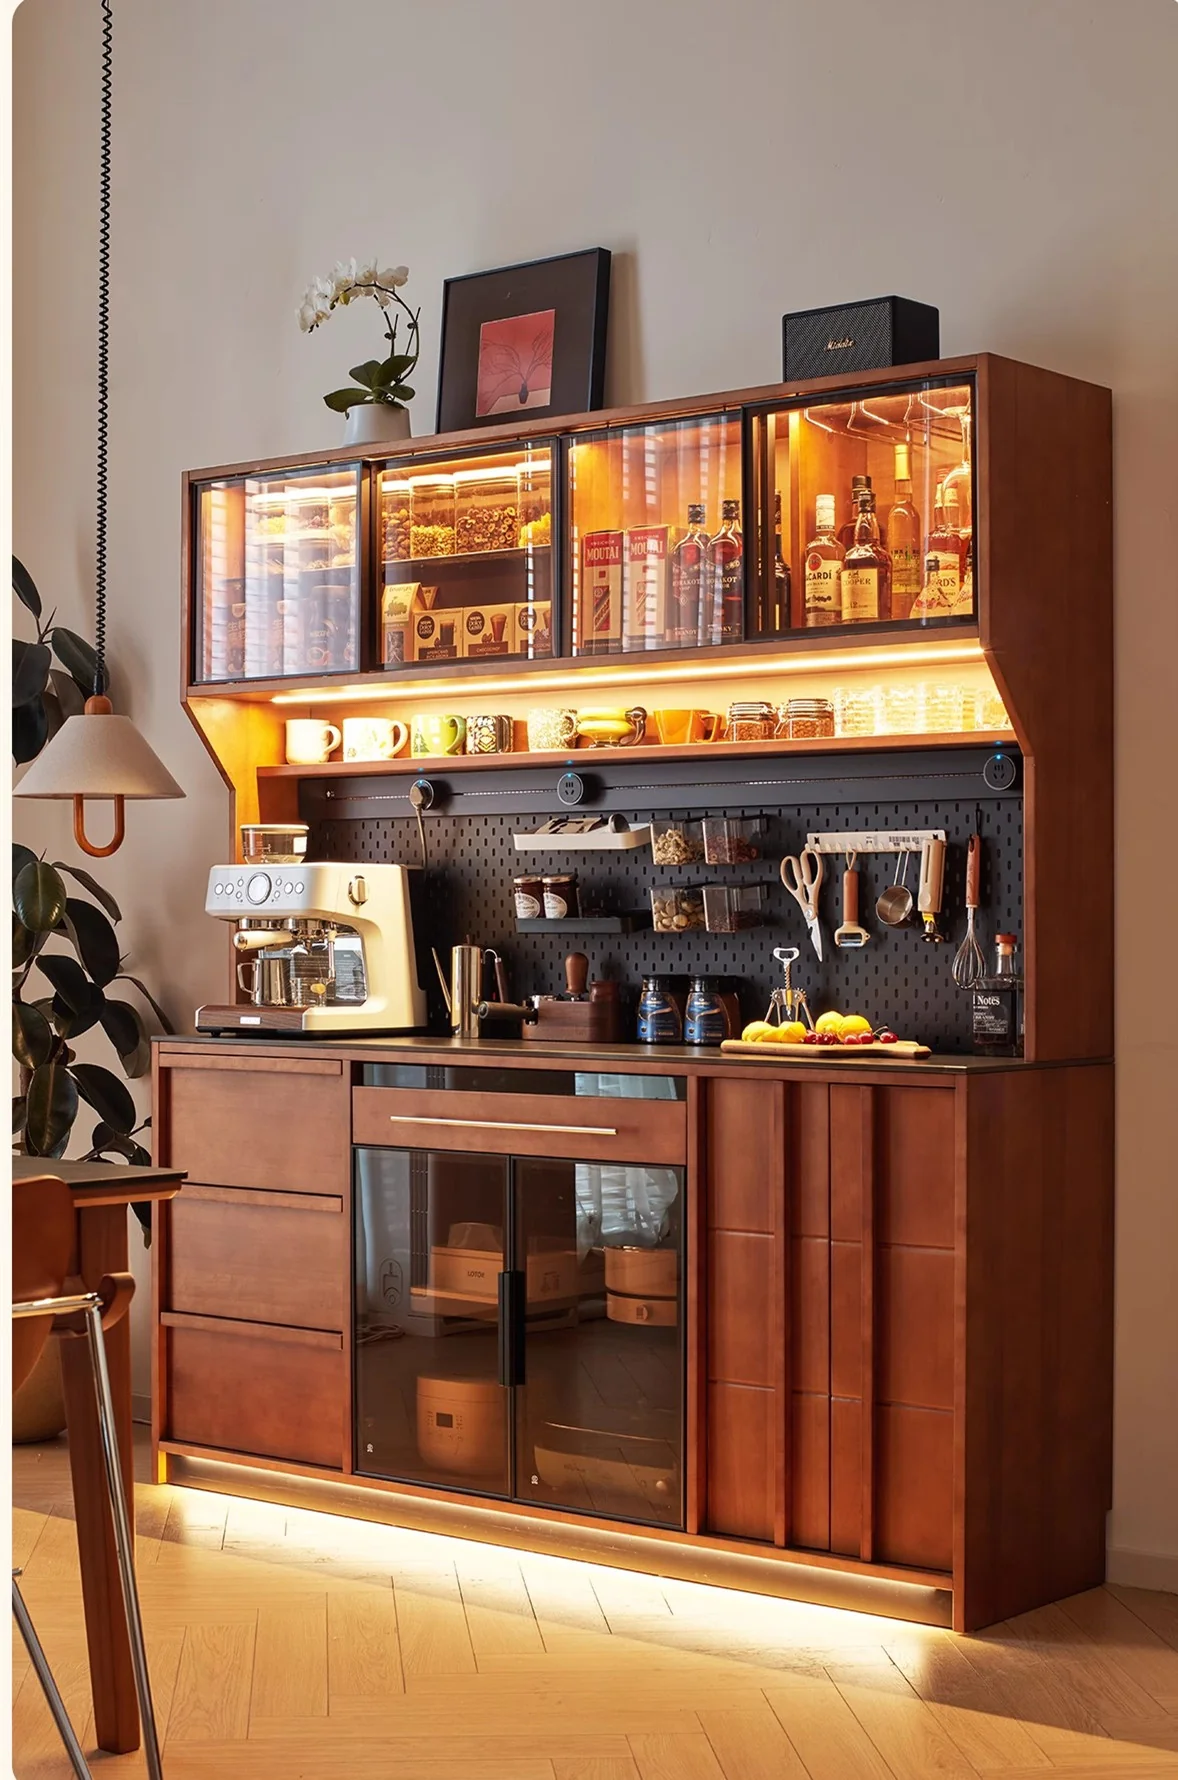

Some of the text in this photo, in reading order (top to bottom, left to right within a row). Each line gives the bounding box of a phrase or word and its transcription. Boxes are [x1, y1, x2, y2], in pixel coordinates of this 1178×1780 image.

[587, 546, 619, 561] MOUTAI
[630, 541, 663, 556] MOUAI
[977, 995, 1000, 1006] Notes
